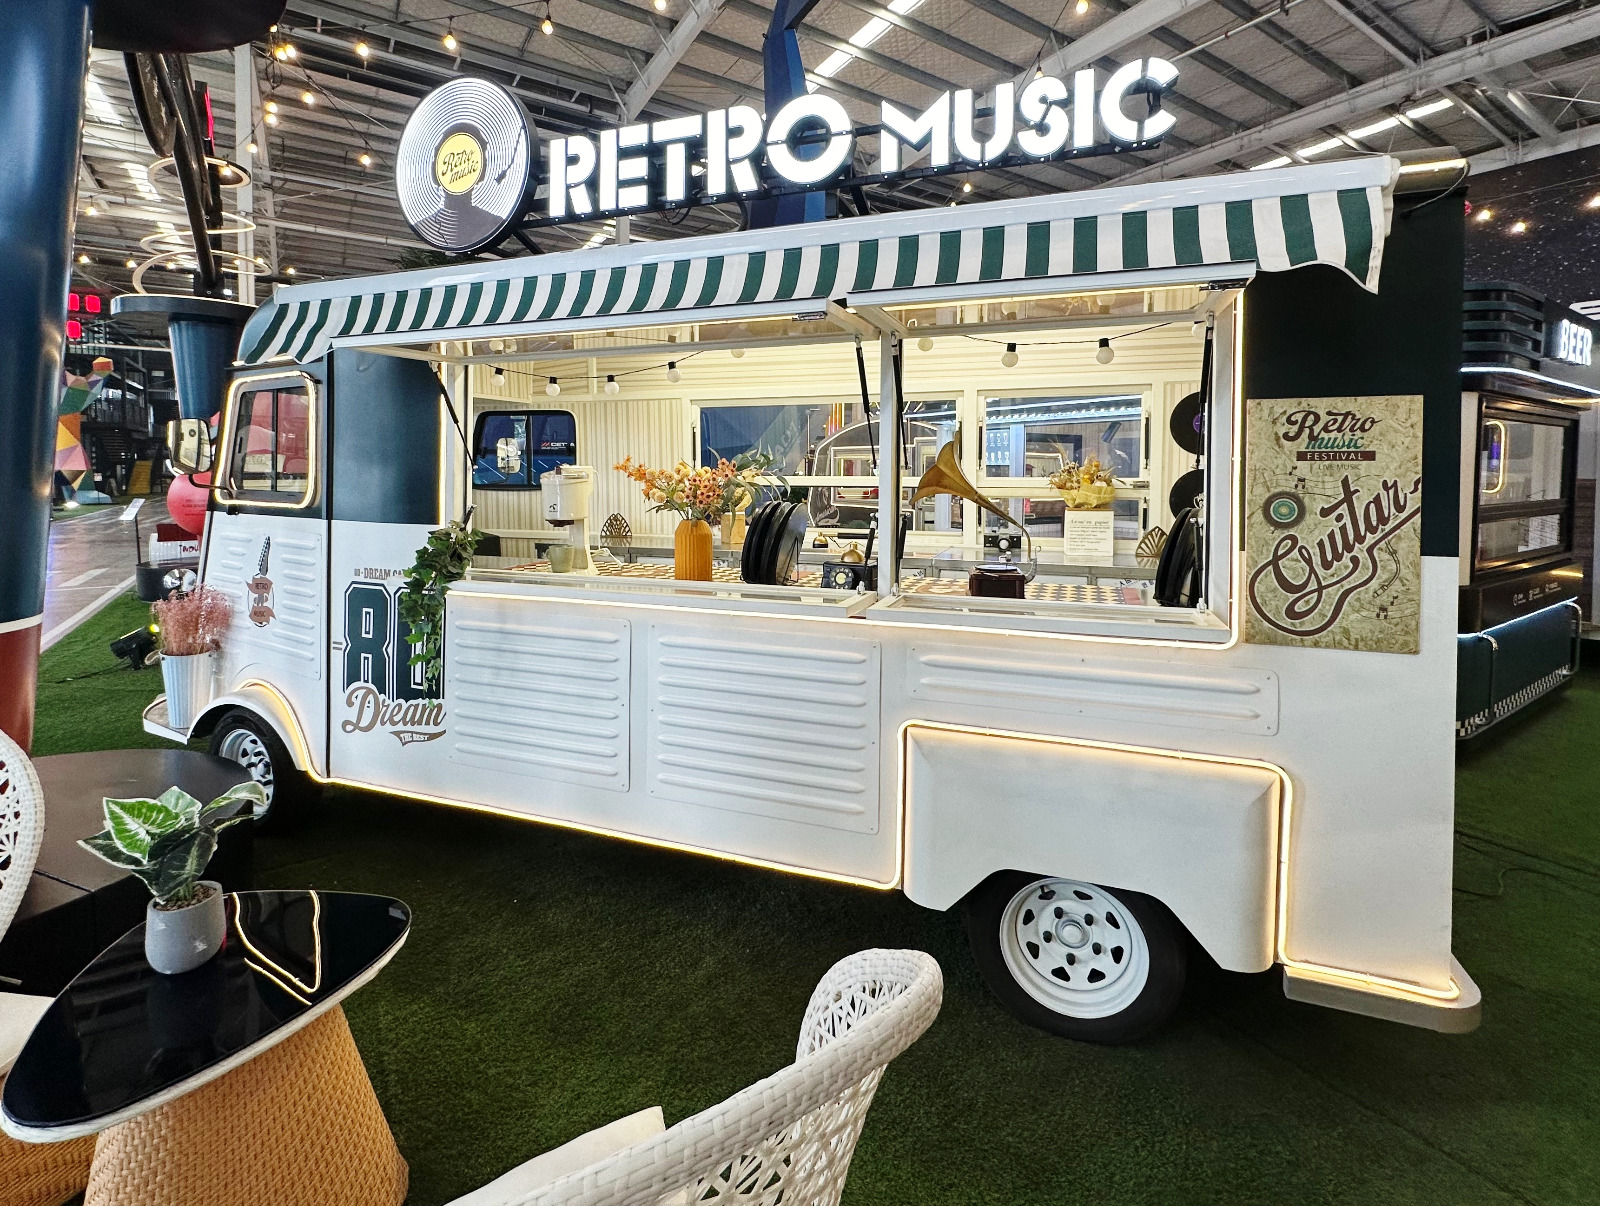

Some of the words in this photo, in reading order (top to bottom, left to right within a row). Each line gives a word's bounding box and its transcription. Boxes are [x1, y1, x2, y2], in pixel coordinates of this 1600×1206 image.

[549, 93, 853, 217] RETRO
[880, 56, 1180, 173] MUSIC
[441, 149, 475, 177] Retro
[449, 159, 479, 185] music
[1558, 318, 1593, 367] BEER
[1282, 410, 1382, 442] Retro
[1305, 433, 1365, 450] music
[1307, 452, 1364, 461] FESTIVAL
[1249, 474, 1421, 637] Guitar
[363, 568, 391, 581] DREAM
[341, 686, 447, 733] Dream
